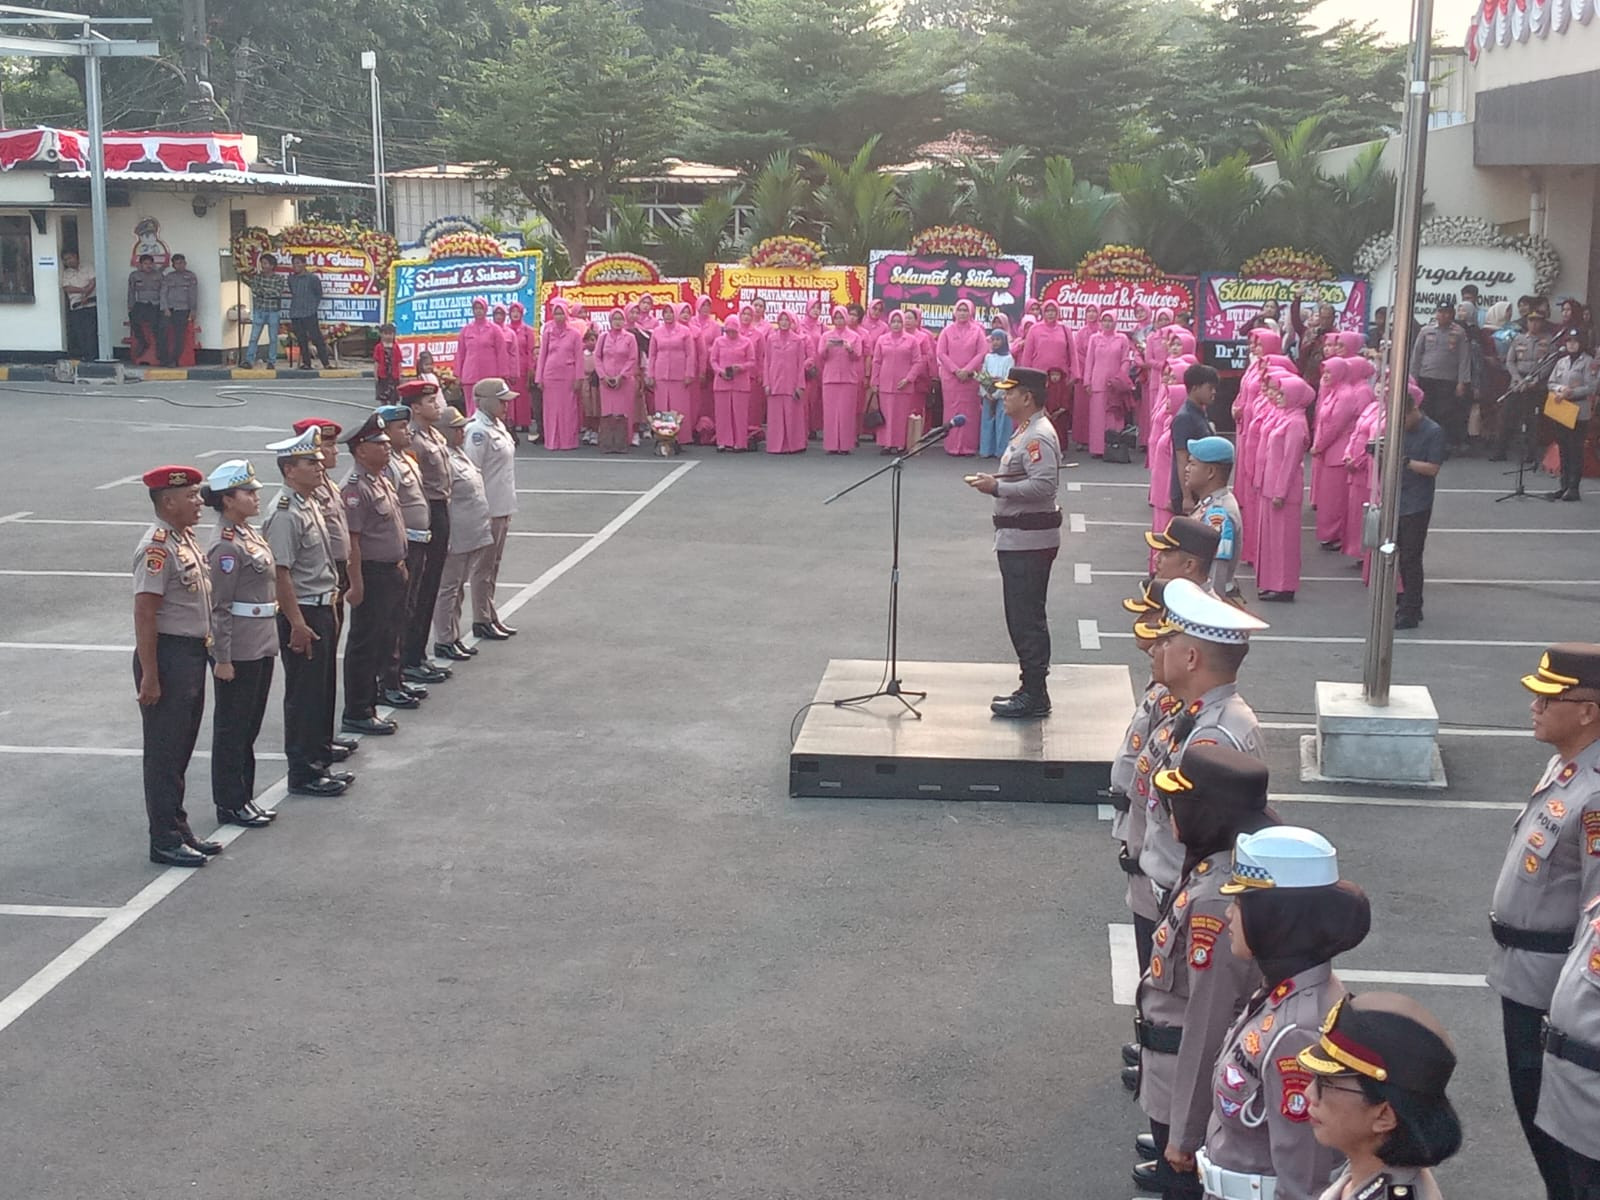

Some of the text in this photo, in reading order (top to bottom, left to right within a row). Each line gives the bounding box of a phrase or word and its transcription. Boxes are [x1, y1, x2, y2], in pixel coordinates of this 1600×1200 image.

[319, 273, 364, 282] ANGKARA
[416, 266, 517, 289] Selamat & Sukses
[731, 273, 838, 289] Selamat & Sukses
[890, 266, 1011, 288] Selamat & Sukses
[618, 292, 626, 306] &
[740, 288, 756, 300] HUT
[757, 289, 808, 301] BHAYANGKARA
[1057, 284, 1180, 308] Selamat & Sukses
[1220, 281, 1276, 301] Selamat
[1279, 289, 1288, 301] &
[412, 300, 428, 311] HUT
[1215, 344, 1234, 359] Dr
[1537, 811, 1561, 837] POLRI
